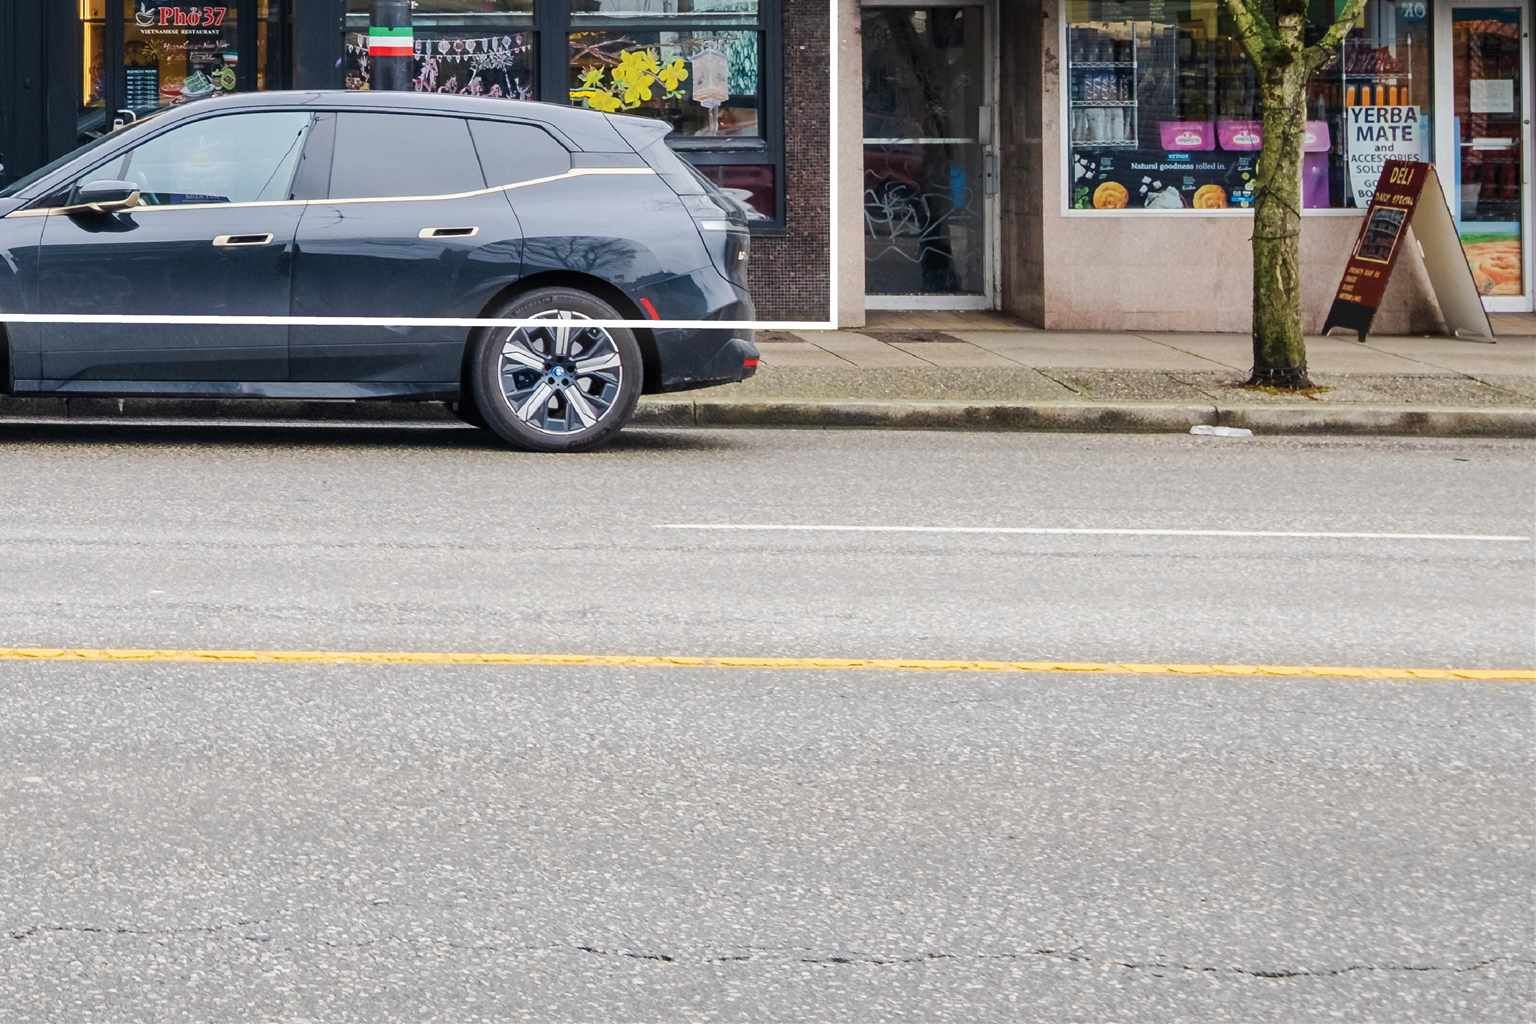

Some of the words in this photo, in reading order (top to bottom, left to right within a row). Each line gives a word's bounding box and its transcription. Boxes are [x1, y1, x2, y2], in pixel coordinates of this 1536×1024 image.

[1351, 107, 1418, 124] YERBA
[1356, 125, 1413, 142] MATE
[1374, 143, 1395, 152] and
[1131, 161, 1158, 171] Natural
[1159, 161, 1194, 172] goodness
[1195, 161, 1216, 170] rolled
[1389, 167, 1415, 185] DELI
